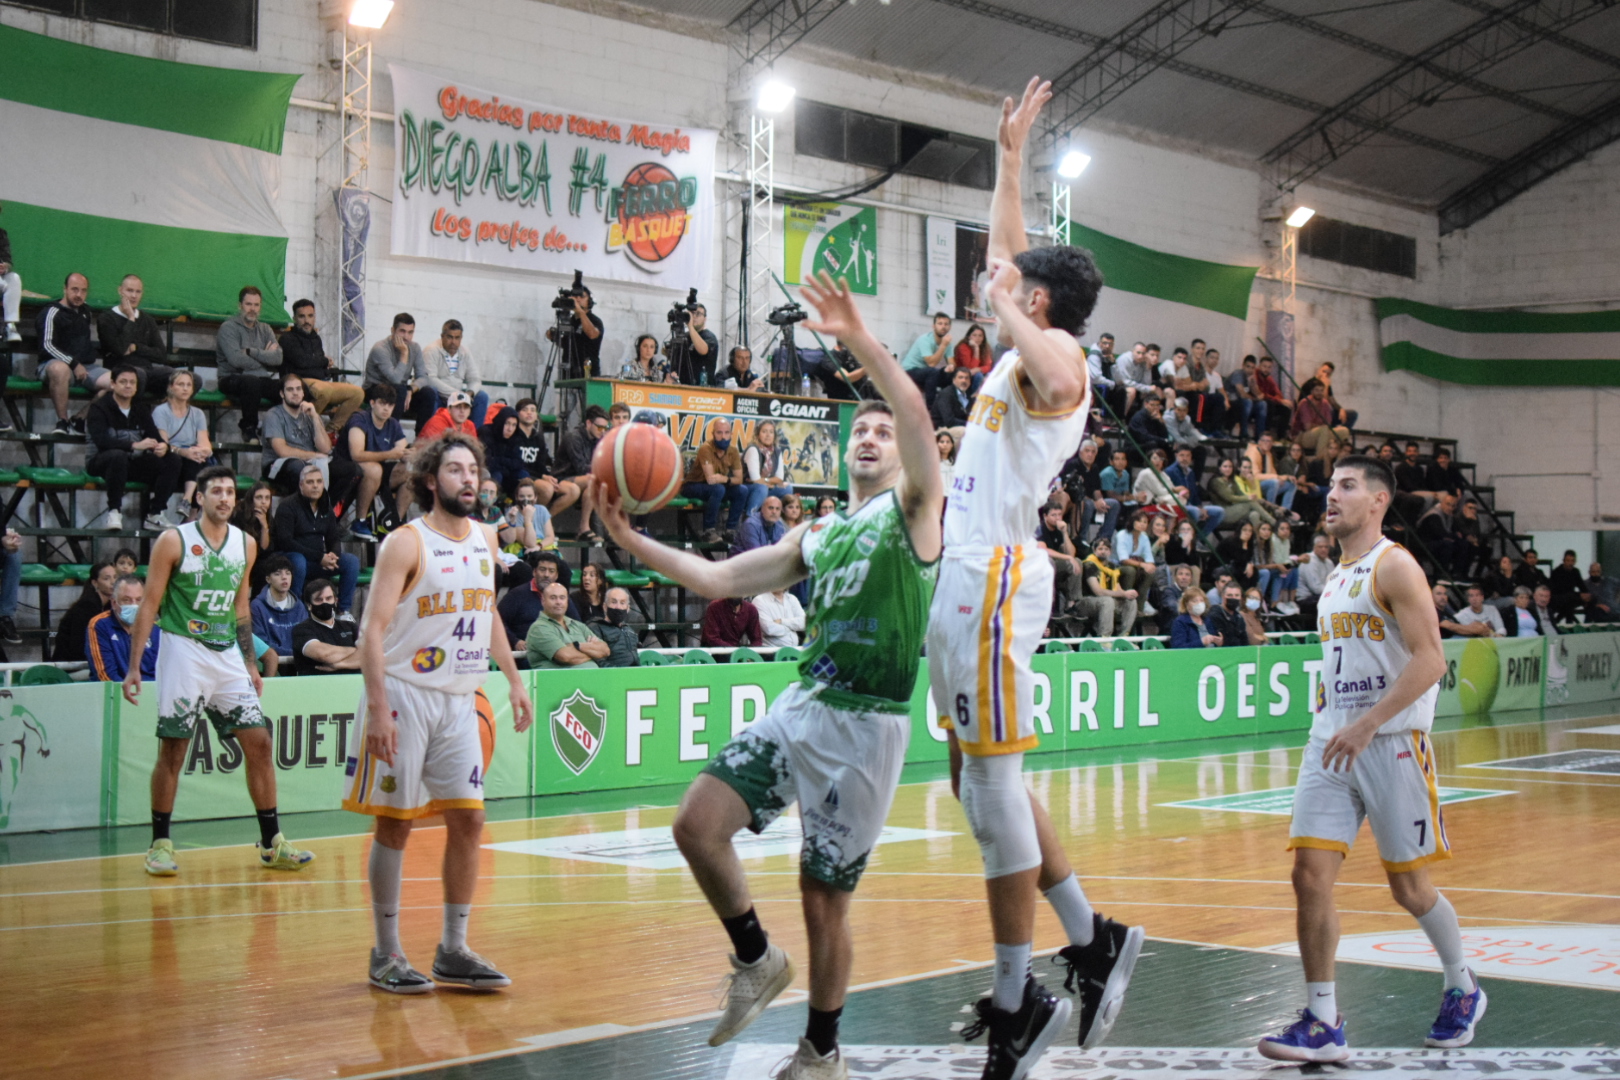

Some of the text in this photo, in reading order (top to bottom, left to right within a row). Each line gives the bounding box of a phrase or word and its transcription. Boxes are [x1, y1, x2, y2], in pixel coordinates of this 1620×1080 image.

[439, 85, 691, 155] Gracias por tanta Magia
[400, 107, 609, 217] DIEGO ALBA #4
[608, 176, 698, 222] FERRO
[432, 207, 472, 240] Los
[477, 218, 539, 251] profes
[687, 396, 727, 406] coach
[736, 406, 759, 414] OFICIAL
[737, 398, 759, 407] AGENTE
[781, 402, 830, 419] GIANT
[416, 590, 457, 619] ALL
[452, 616, 476, 642] 44
[1330, 611, 1386, 643] BOYS
[456, 647, 484, 661] Canal
[1333, 645, 1343, 675] 7
[1197, 658, 1323, 723] OEST
[1334, 675, 1387, 694] Canal 3
[956, 691, 970, 727] 6
[564, 711, 592, 751] FCO
[1413, 819, 1427, 847] 7
